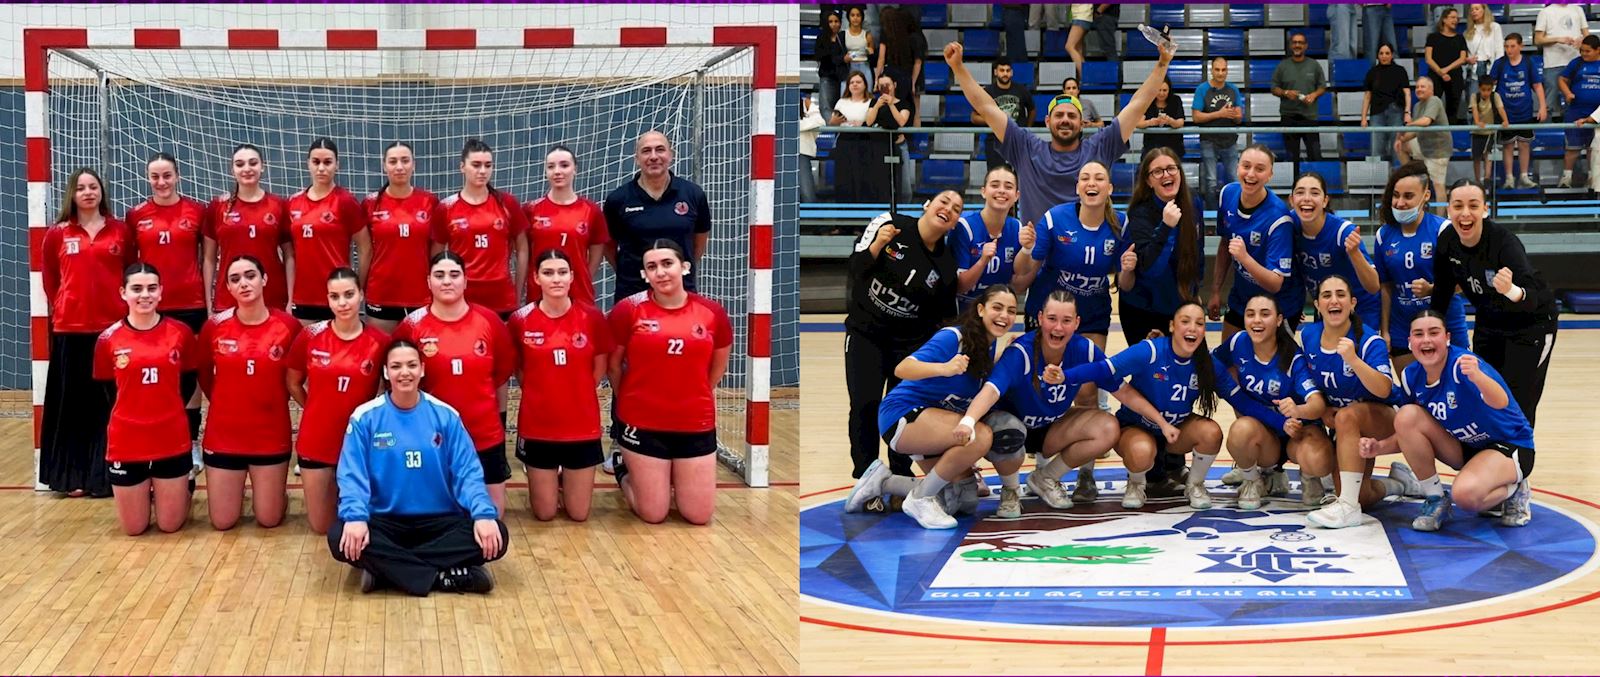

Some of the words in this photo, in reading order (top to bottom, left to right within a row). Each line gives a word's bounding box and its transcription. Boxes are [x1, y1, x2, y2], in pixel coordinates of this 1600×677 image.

[159, 231, 171, 245] 21
[249, 225, 257, 239] 3
[302, 225, 314, 238] 25
[560, 233, 568, 247] 7
[475, 234, 489, 248] 35
[1084, 246, 1096, 265] 11
[1301, 252, 1318, 269] 23
[1404, 251, 1415, 269] 8
[986, 256, 1000, 274] 10
[904, 269, 917, 286] 1
[1467, 276, 1483, 295] 16
[667, 339, 684, 355] 22
[553, 349, 567, 366] 18
[142, 367, 158, 384] 26
[247, 360, 255, 375] 5
[337, 376, 350, 392] 17
[1245, 375, 1264, 395] 24
[1320, 371, 1337, 389] 71
[1048, 384, 1067, 403] 32
[1170, 383, 1188, 401] 21
[1428, 402, 1448, 420] 28
[405, 451, 421, 468] 33
[1044, 590, 1083, 598] של
[1175, 589, 1243, 597] קרית
[1331, 589, 1404, 598] חולון
